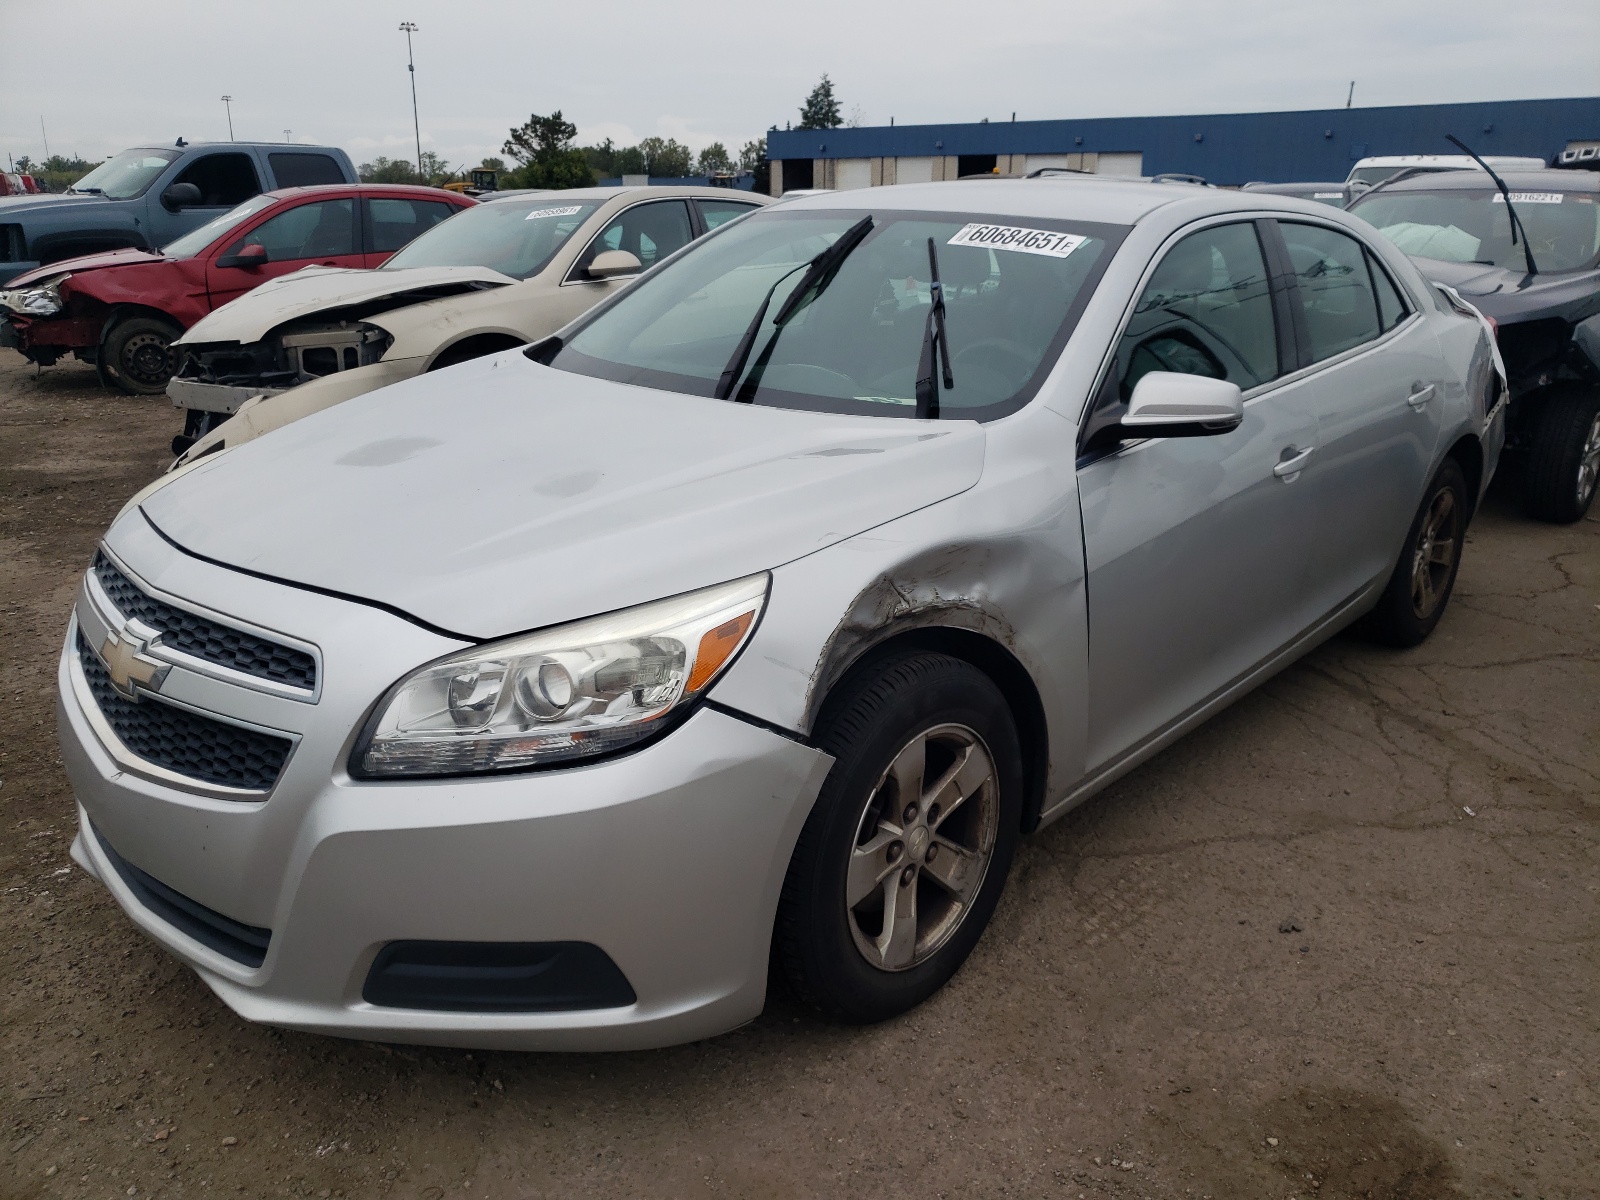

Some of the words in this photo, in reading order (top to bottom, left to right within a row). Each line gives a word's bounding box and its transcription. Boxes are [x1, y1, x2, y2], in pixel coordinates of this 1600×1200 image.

[1504, 193, 1554, 202] 0916221
[968, 225, 1067, 251] 60684651
[1060, 241, 1074, 251] F
